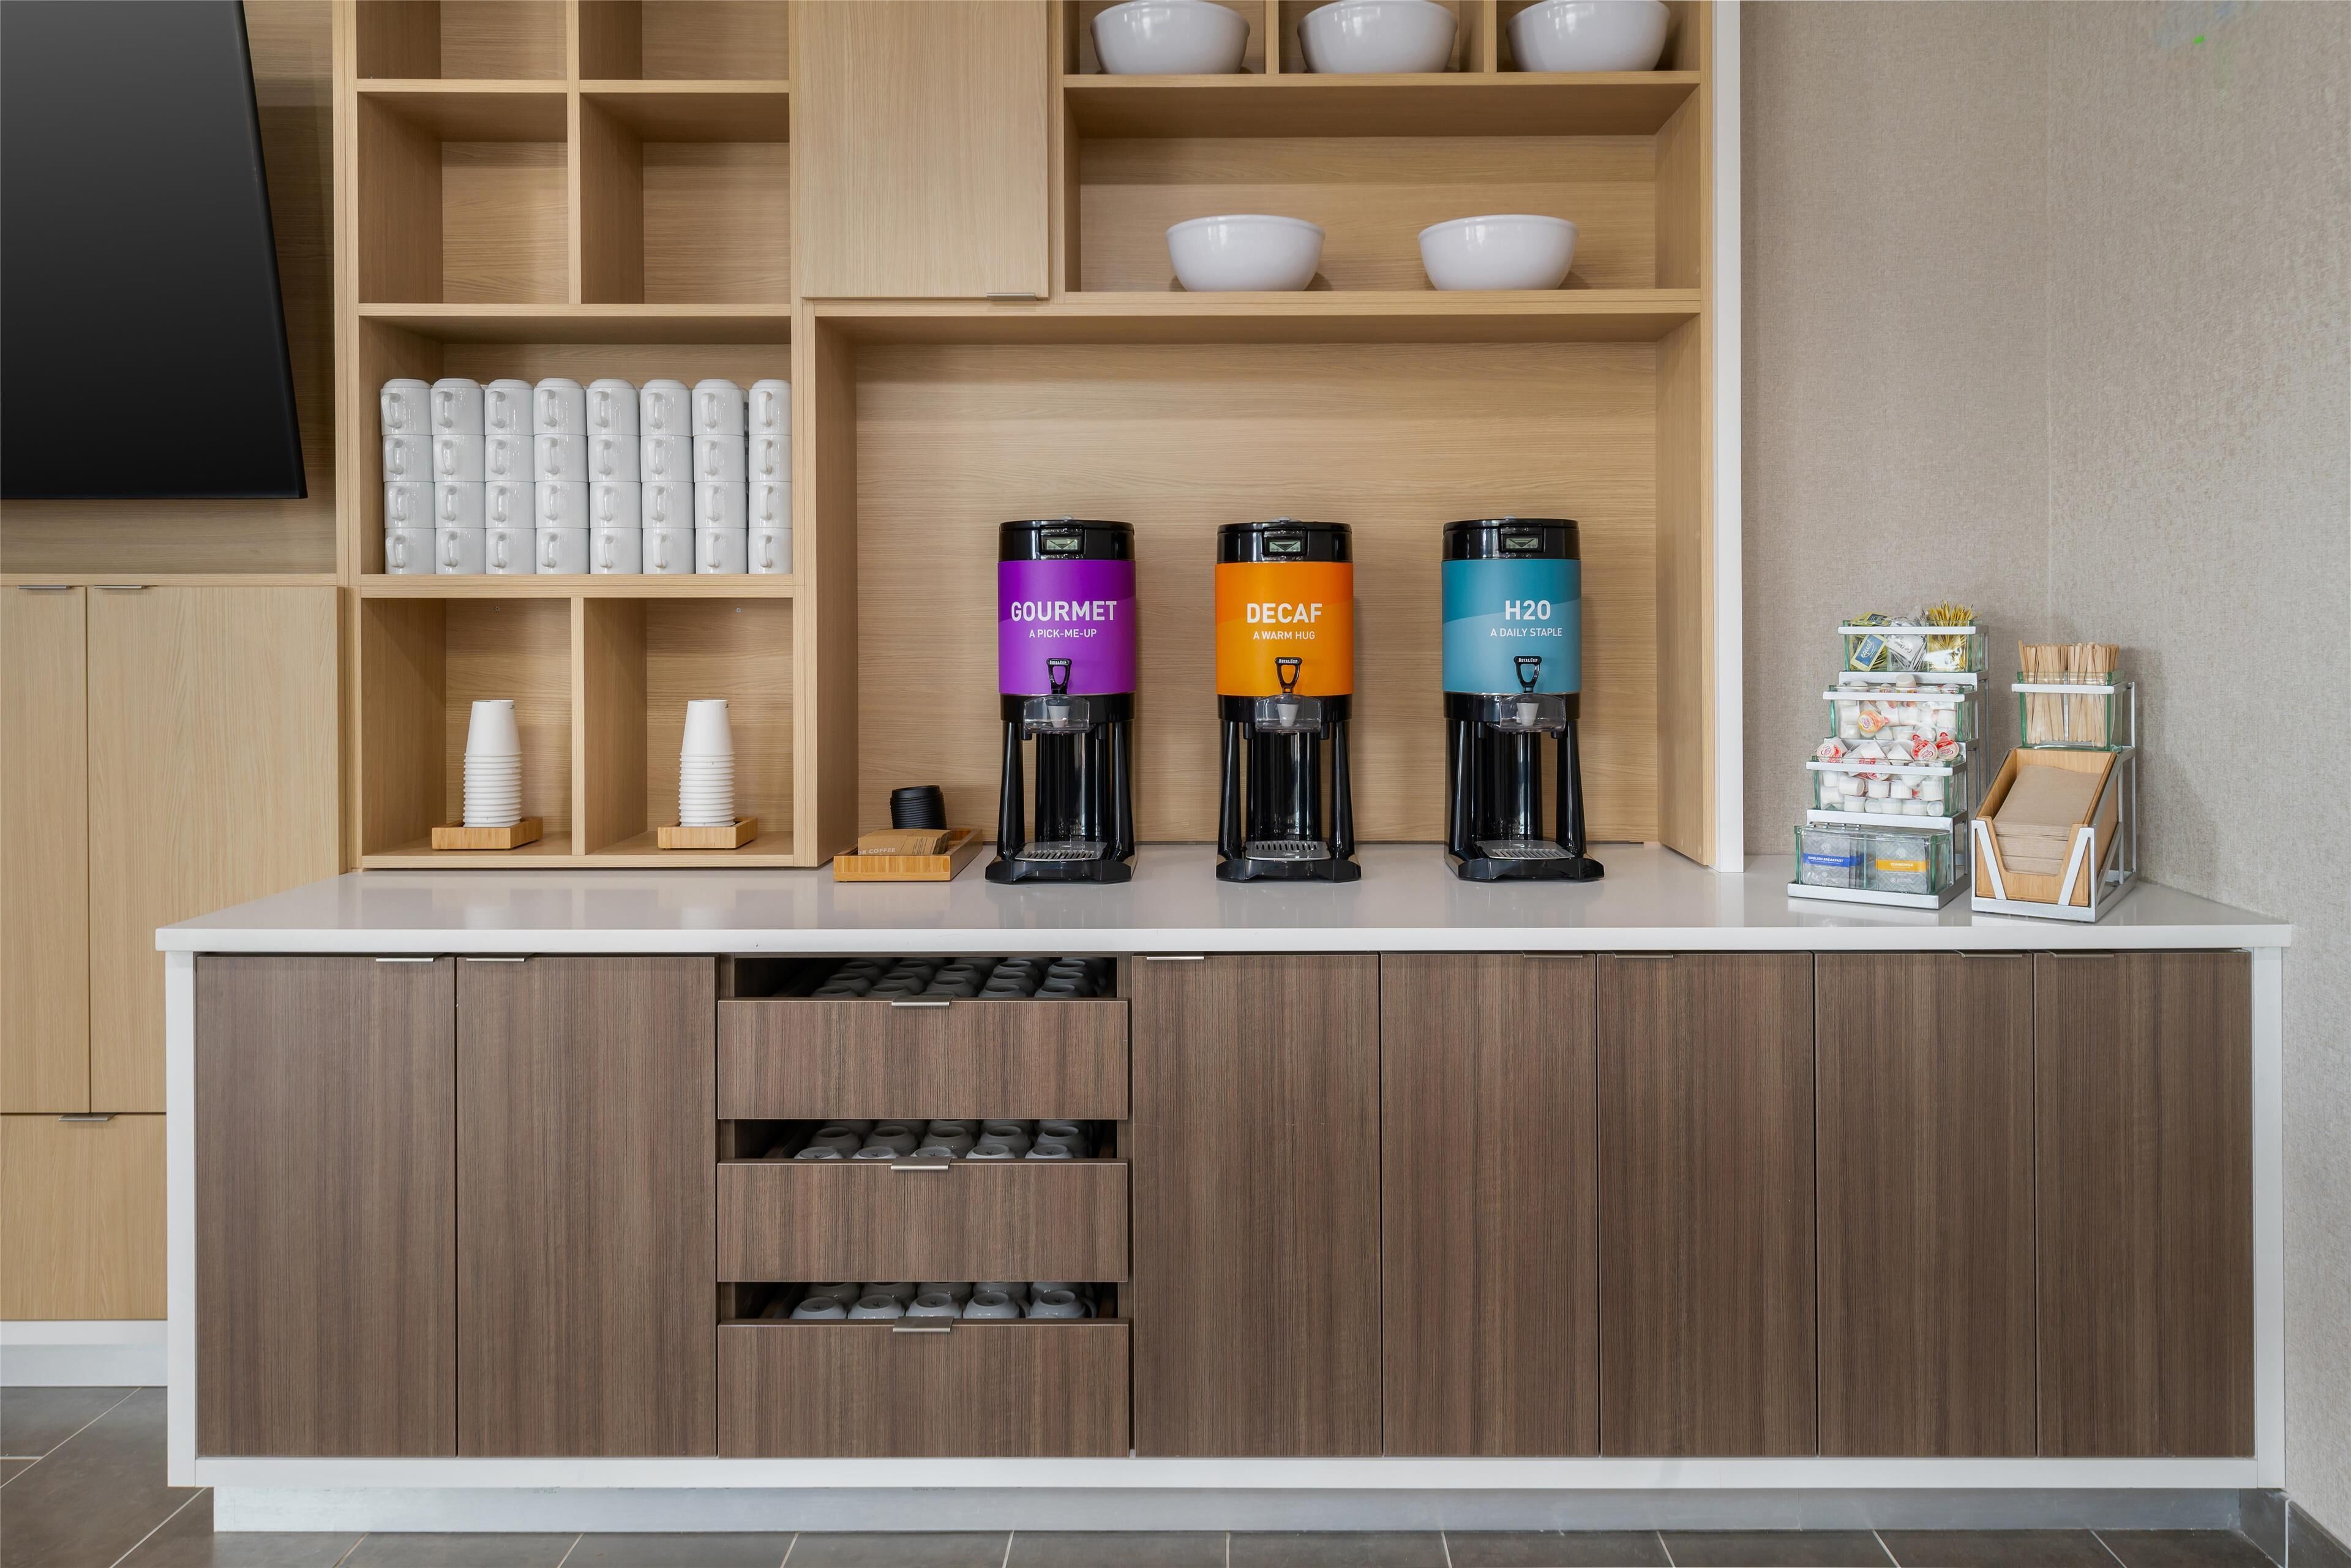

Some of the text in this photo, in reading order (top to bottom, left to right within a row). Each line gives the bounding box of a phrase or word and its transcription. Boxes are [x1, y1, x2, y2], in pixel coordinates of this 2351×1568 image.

[1011, 601, 1117, 621] GOURMET
[1247, 603, 1322, 623] DECAF
[1029, 629, 1097, 638] A PICK-ME-UP
[1253, 631, 1315, 640] A WARM HUG
[1490, 628, 1562, 637] A DAILY STAPLE
[1860, 639, 1875, 659] equal
